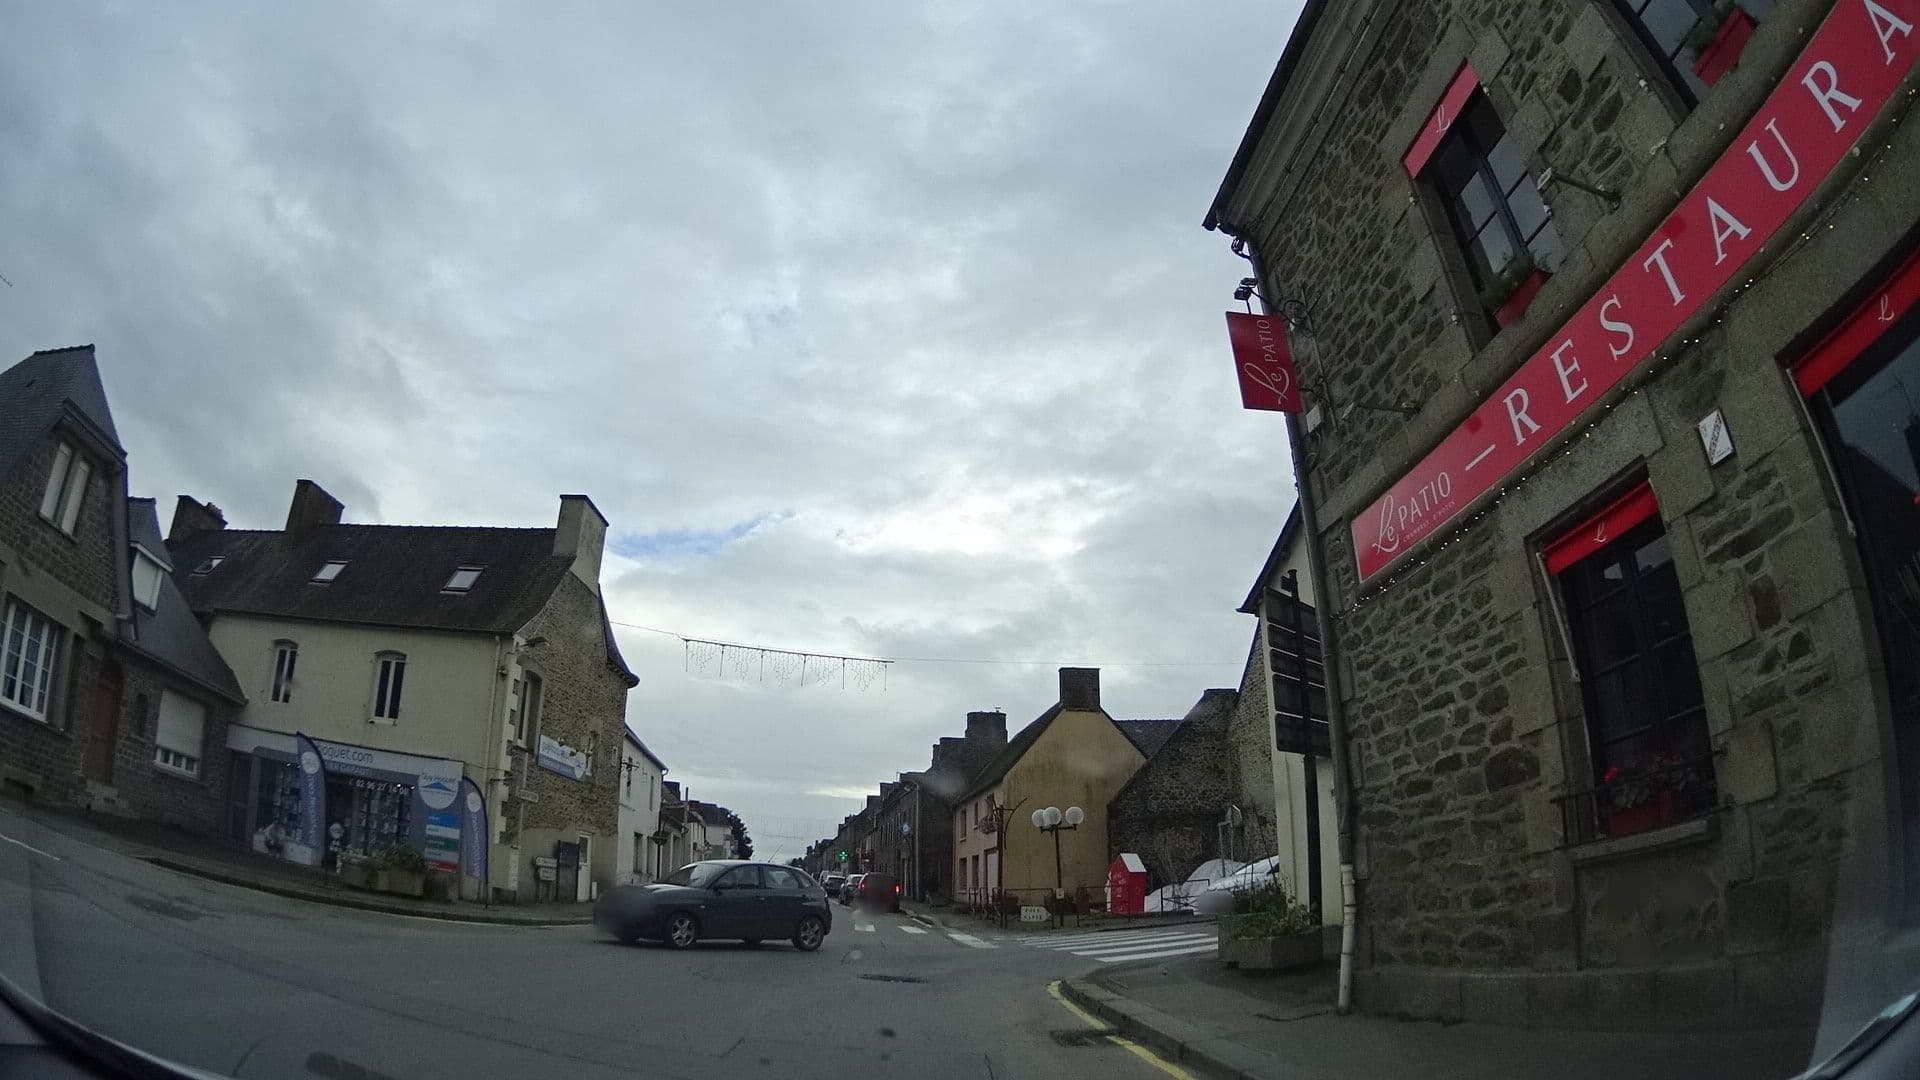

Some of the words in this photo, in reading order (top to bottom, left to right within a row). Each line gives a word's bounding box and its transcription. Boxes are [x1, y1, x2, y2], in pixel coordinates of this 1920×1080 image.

[1503, 0, 1914, 446] RESTAURA
[1256, 319, 1279, 363] PATIO
[1244, 362, 1290, 405] Le
[1372, 494, 1399, 556] Le
[1398, 472, 1451, 530] PATIO
